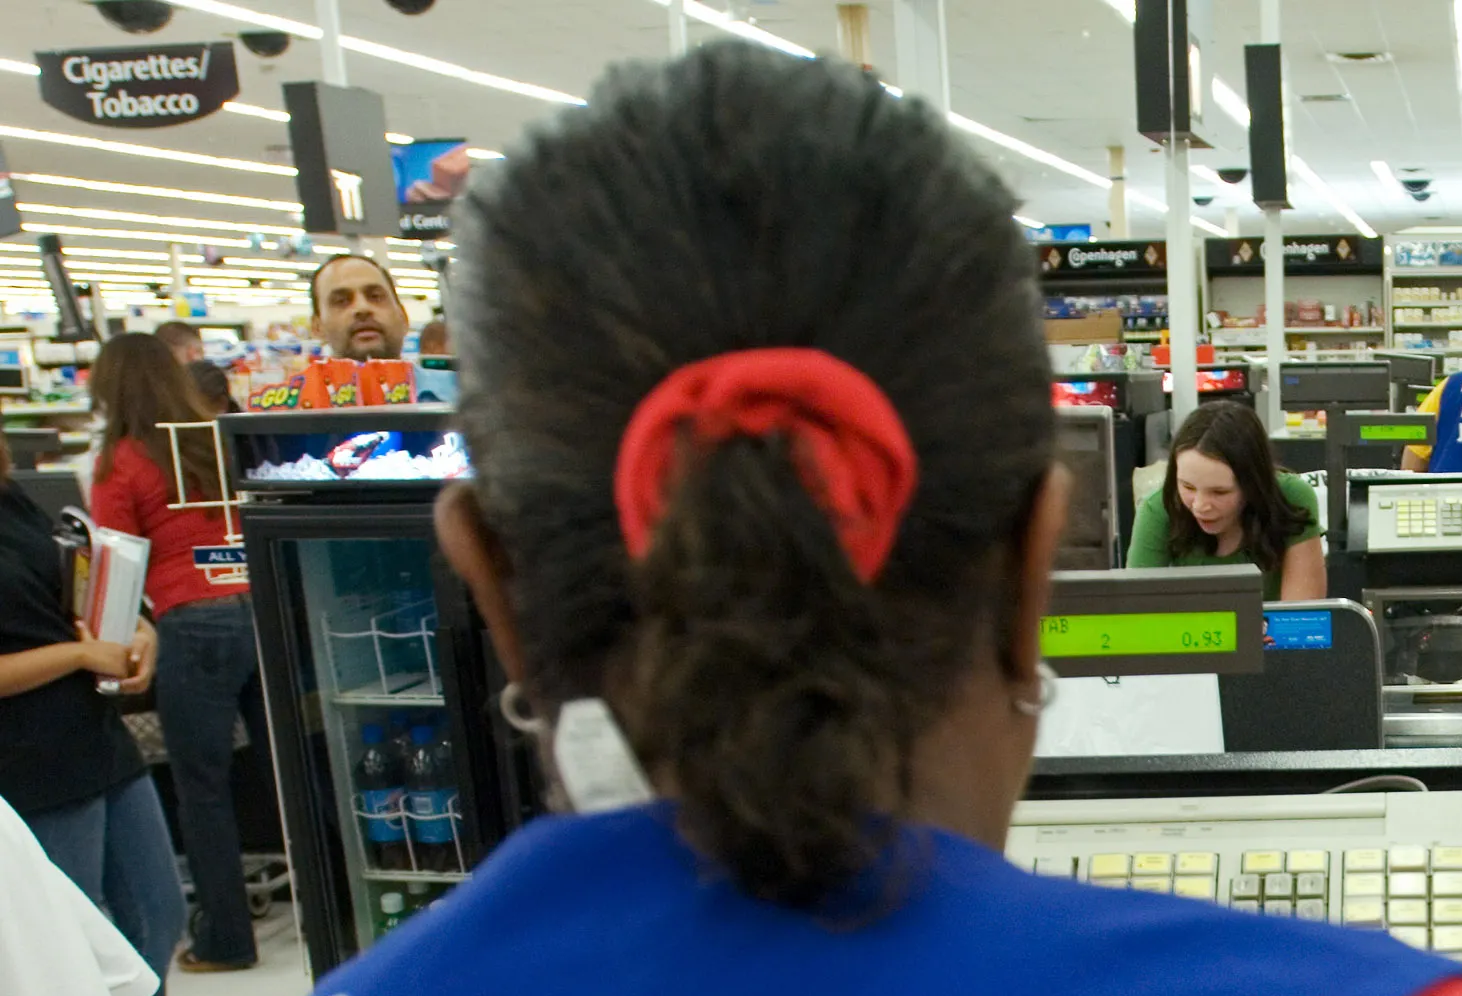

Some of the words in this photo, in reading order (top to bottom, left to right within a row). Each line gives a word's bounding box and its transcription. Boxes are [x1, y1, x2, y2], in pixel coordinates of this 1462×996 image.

[62, 47, 211, 90] Cigarettes/
[86, 89, 199, 118] Tobacco
[1068, 247, 1139, 269] Copenhagen
[1101, 634, 1110, 649] 2
[1182, 630, 1223, 648] 0.93
